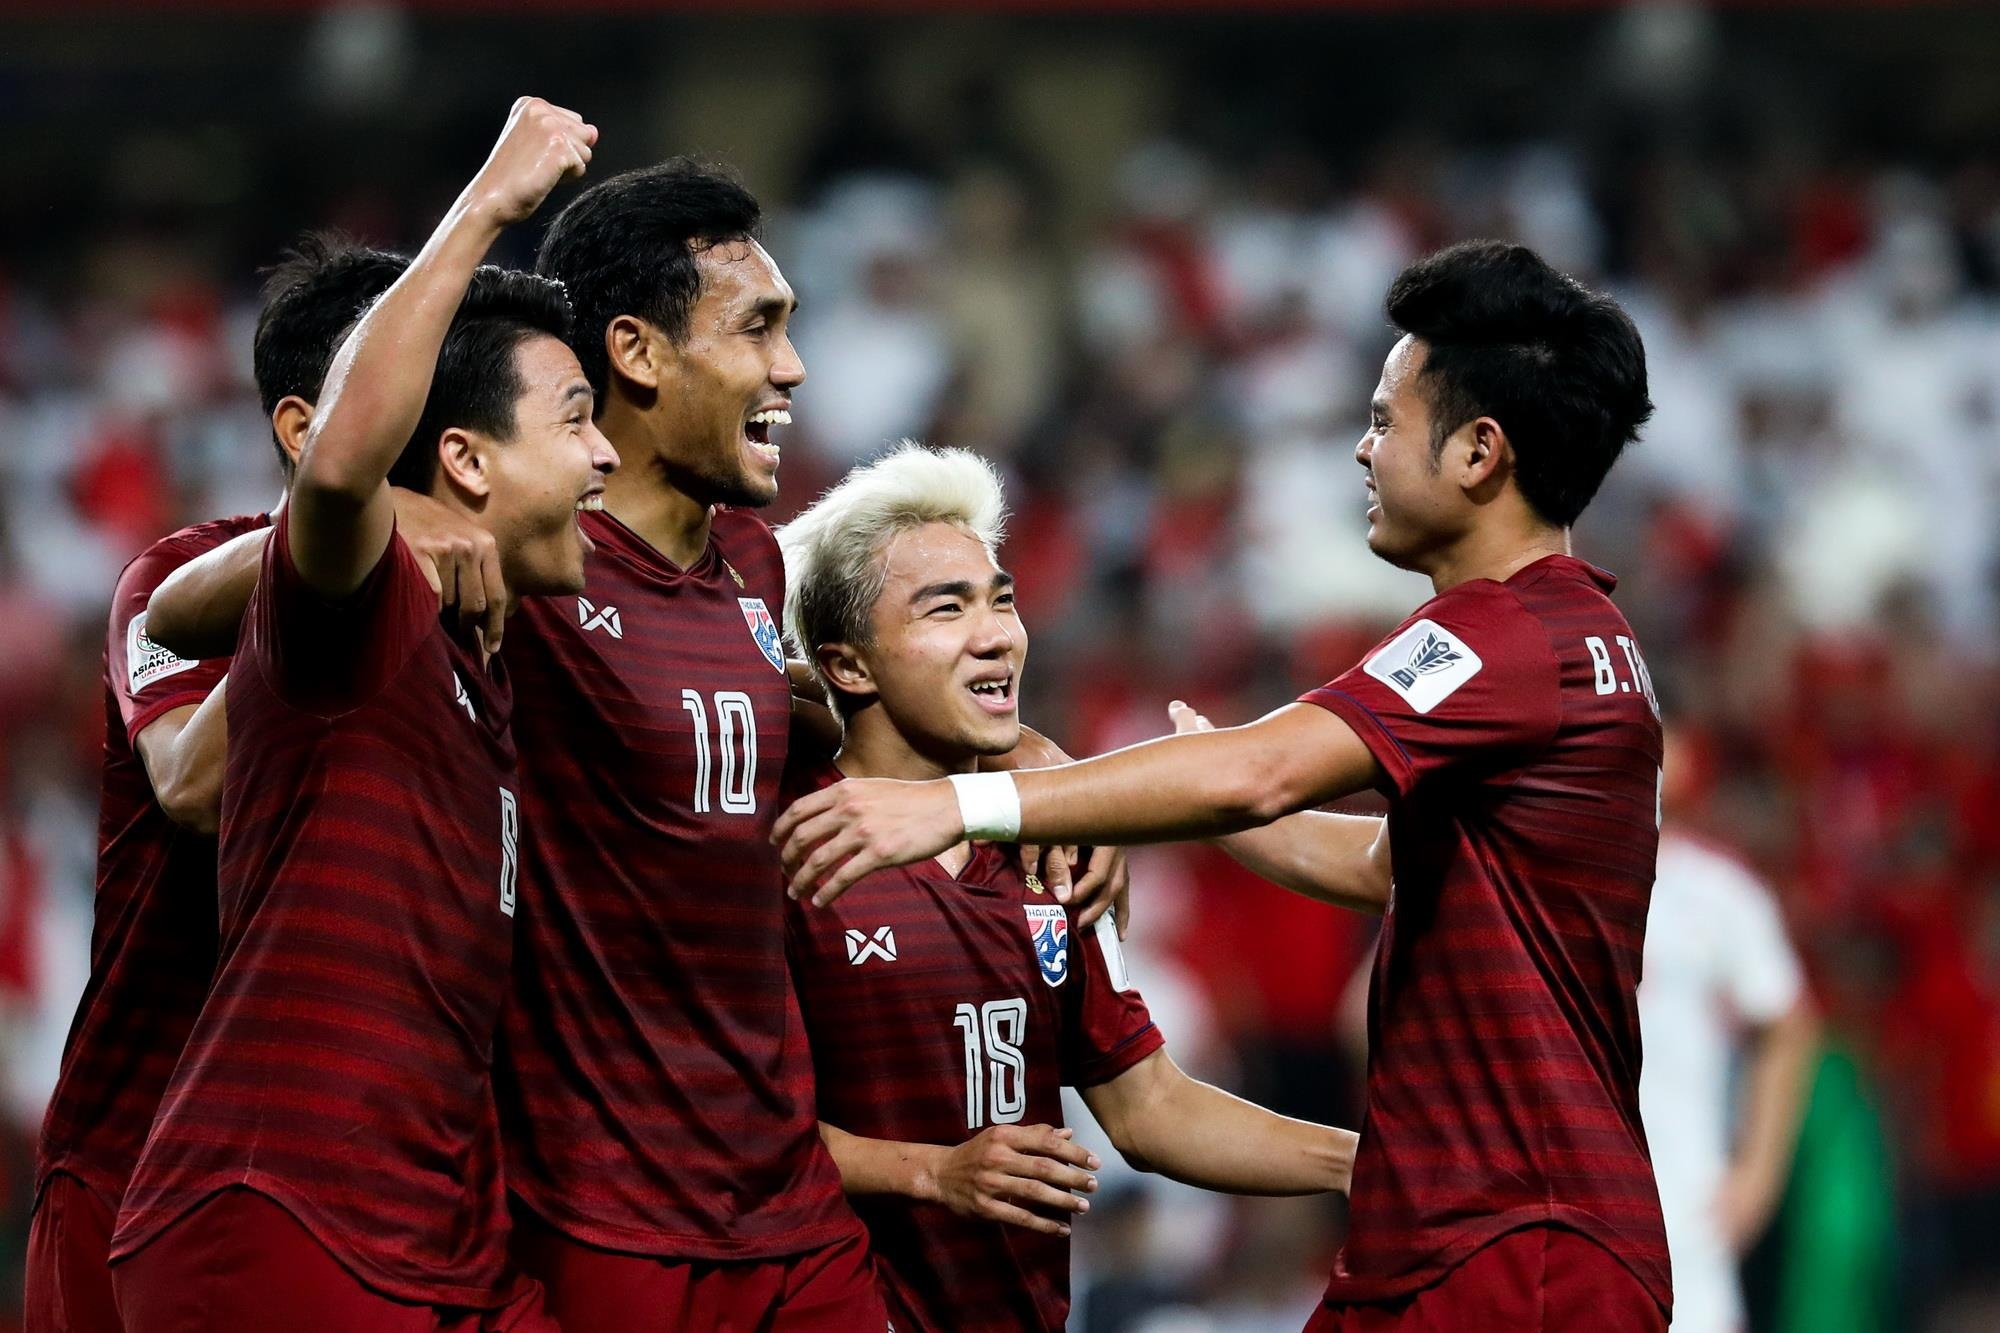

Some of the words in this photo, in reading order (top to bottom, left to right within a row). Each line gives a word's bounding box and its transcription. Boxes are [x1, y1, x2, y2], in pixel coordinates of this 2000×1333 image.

[132, 658, 165, 680] ASIAN
[141, 669, 157, 679] UAE
[160, 661, 181, 672] 2019
[149, 649, 169, 661] AFC
[681, 688, 758, 815] 10
[499, 786, 518, 919] 8
[953, 997, 1028, 1130] 18
